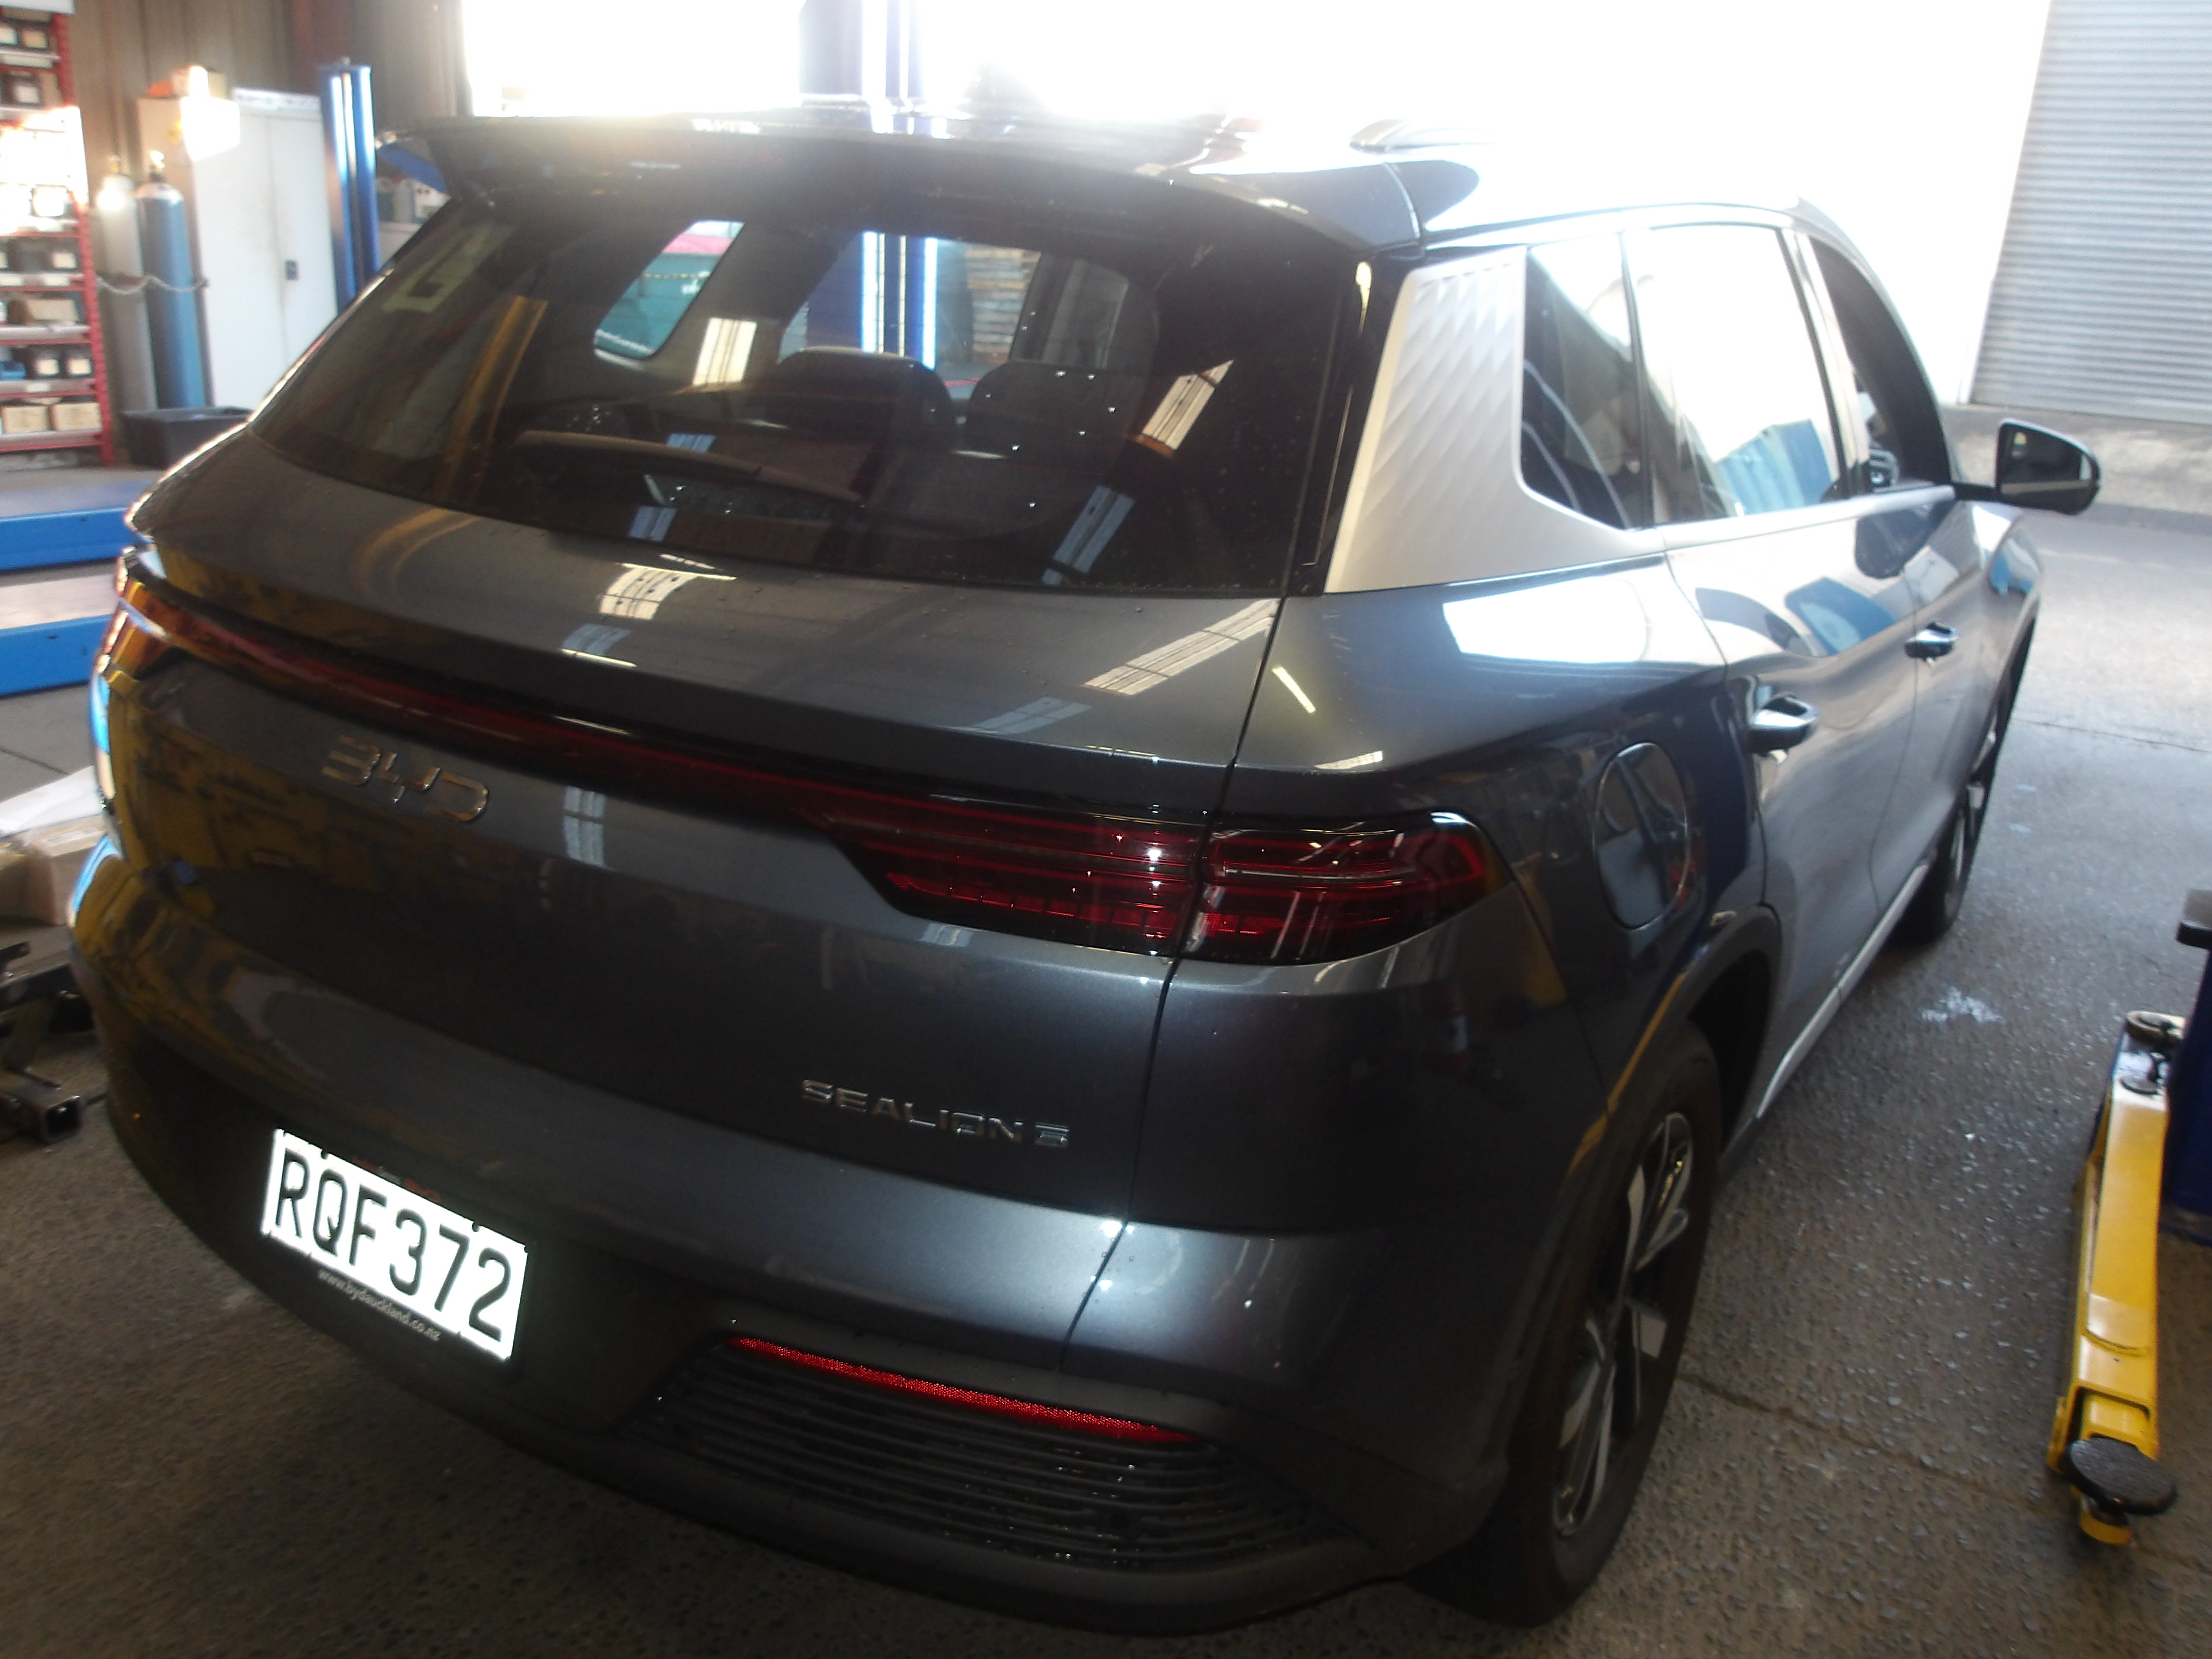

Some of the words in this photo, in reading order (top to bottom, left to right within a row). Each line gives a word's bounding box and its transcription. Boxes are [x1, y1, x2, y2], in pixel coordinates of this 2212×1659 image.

[321, 733, 489, 823] BYD
[802, 1079, 1024, 1143] SEALION
[275, 1147, 512, 1343] RQF372
